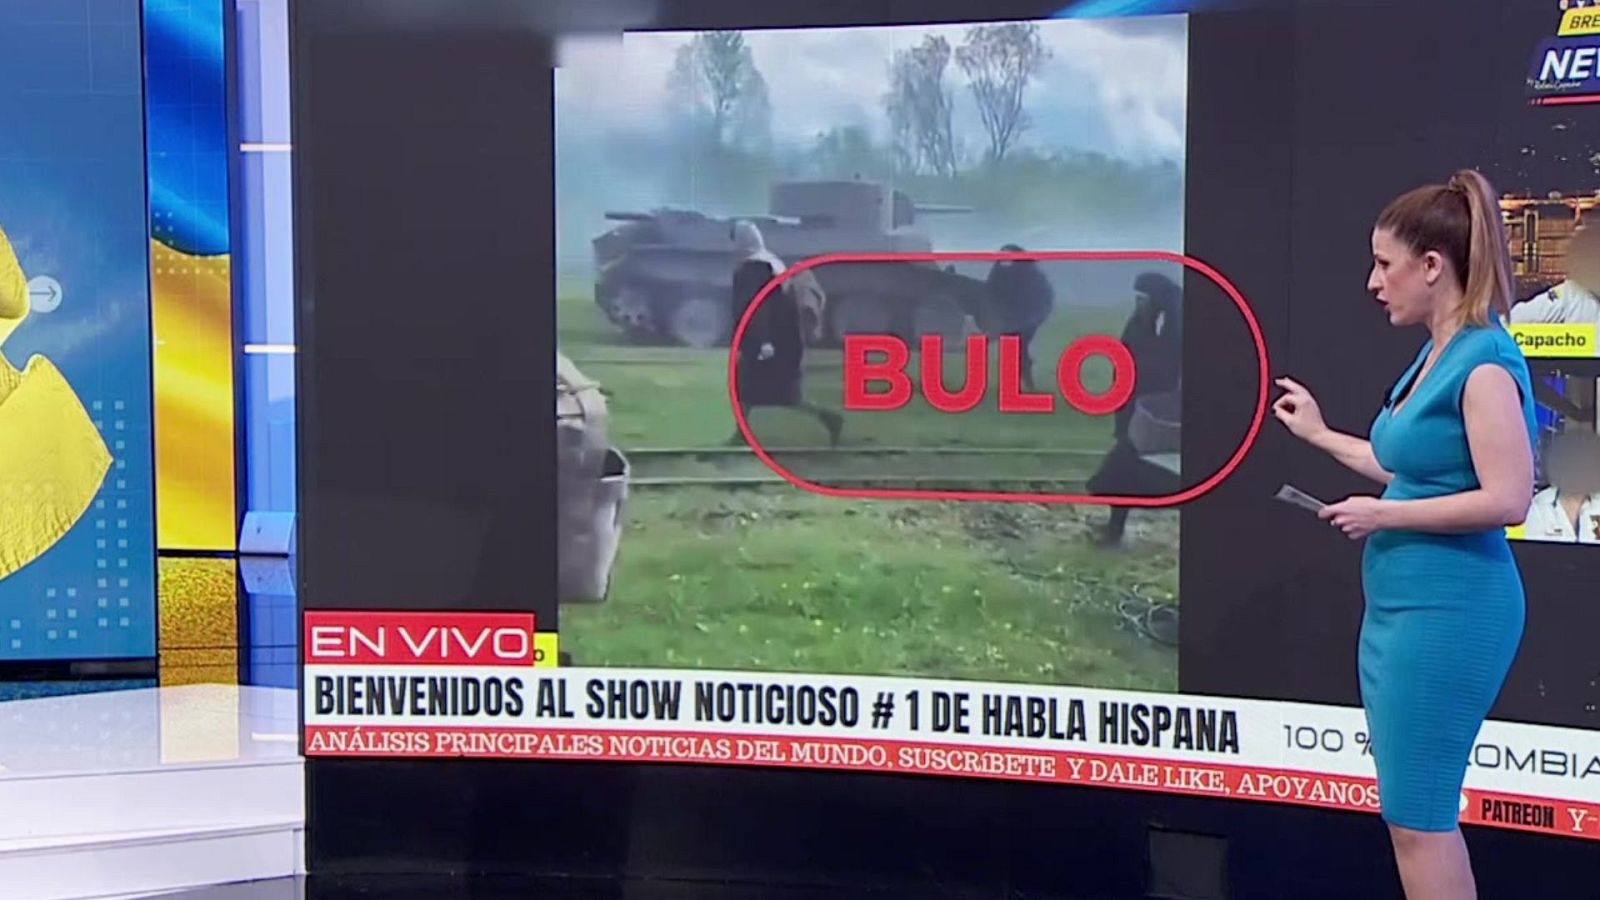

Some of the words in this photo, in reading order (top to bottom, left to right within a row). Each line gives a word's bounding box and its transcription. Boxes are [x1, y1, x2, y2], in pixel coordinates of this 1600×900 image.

[1539, 47, 1600, 81] NE
[1514, 332, 1586, 350] Capacho
[843, 333, 1137, 415] BULO
[311, 626, 385, 657] EN
[398, 627, 528, 658] VIVO
[314, 675, 524, 717] BIENVENIDOS
[536, 678, 575, 718] AL
[586, 678, 681, 721] SHOW
[695, 682, 859, 728] NOTICIOSO
[872, 692, 895, 729] #
[905, 690, 919, 731] 1
[931, 691, 970, 734] DE
[982, 693, 1087, 742] HABLA
[1099, 701, 1239, 754] HISPANA
[309, 727, 430, 752] ANÁLISIS
[435, 732, 604, 756] PRINCIPALES
[609, 735, 731, 761] NOTICIAS
[736, 740, 786, 763] DEL
[790, 742, 893, 769] MUNDO,
[1066, 758, 1085, 780] Y
[1090, 759, 1159, 786] DALE
[1164, 767, 1232, 796] LIKE,
[1236, 772, 1380, 808] APOYANOS
[1481, 798, 1555, 829] PATREON
[1284, 724, 1344, 753] 100
[1467, 743, 1600, 779] OMBIA
